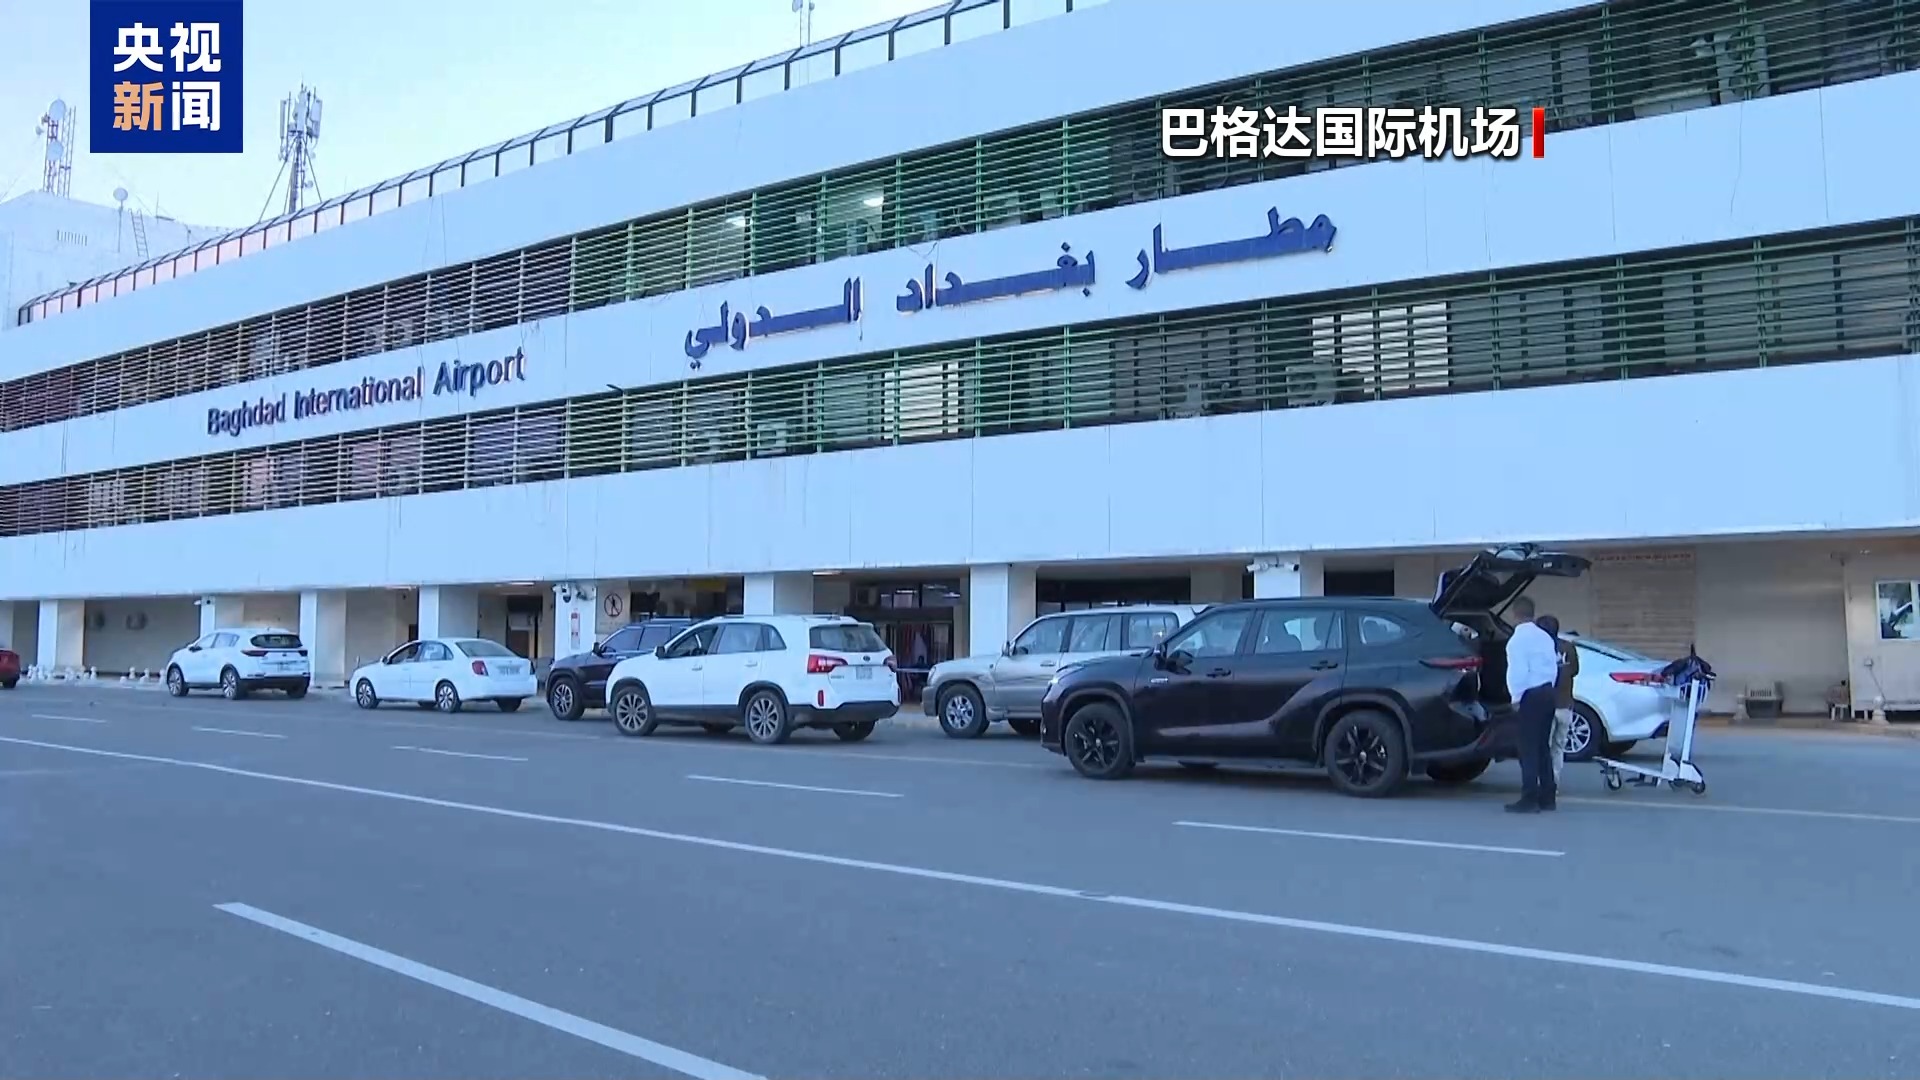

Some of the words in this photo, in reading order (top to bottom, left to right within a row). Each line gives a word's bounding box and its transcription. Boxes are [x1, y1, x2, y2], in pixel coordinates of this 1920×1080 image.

[896, 243, 1096, 313] بغداد
[1126, 206, 1338, 290] مطار
[207, 392, 286, 436] Baghdad
[294, 366, 423, 419] International
[433, 345, 526, 398] Airport
